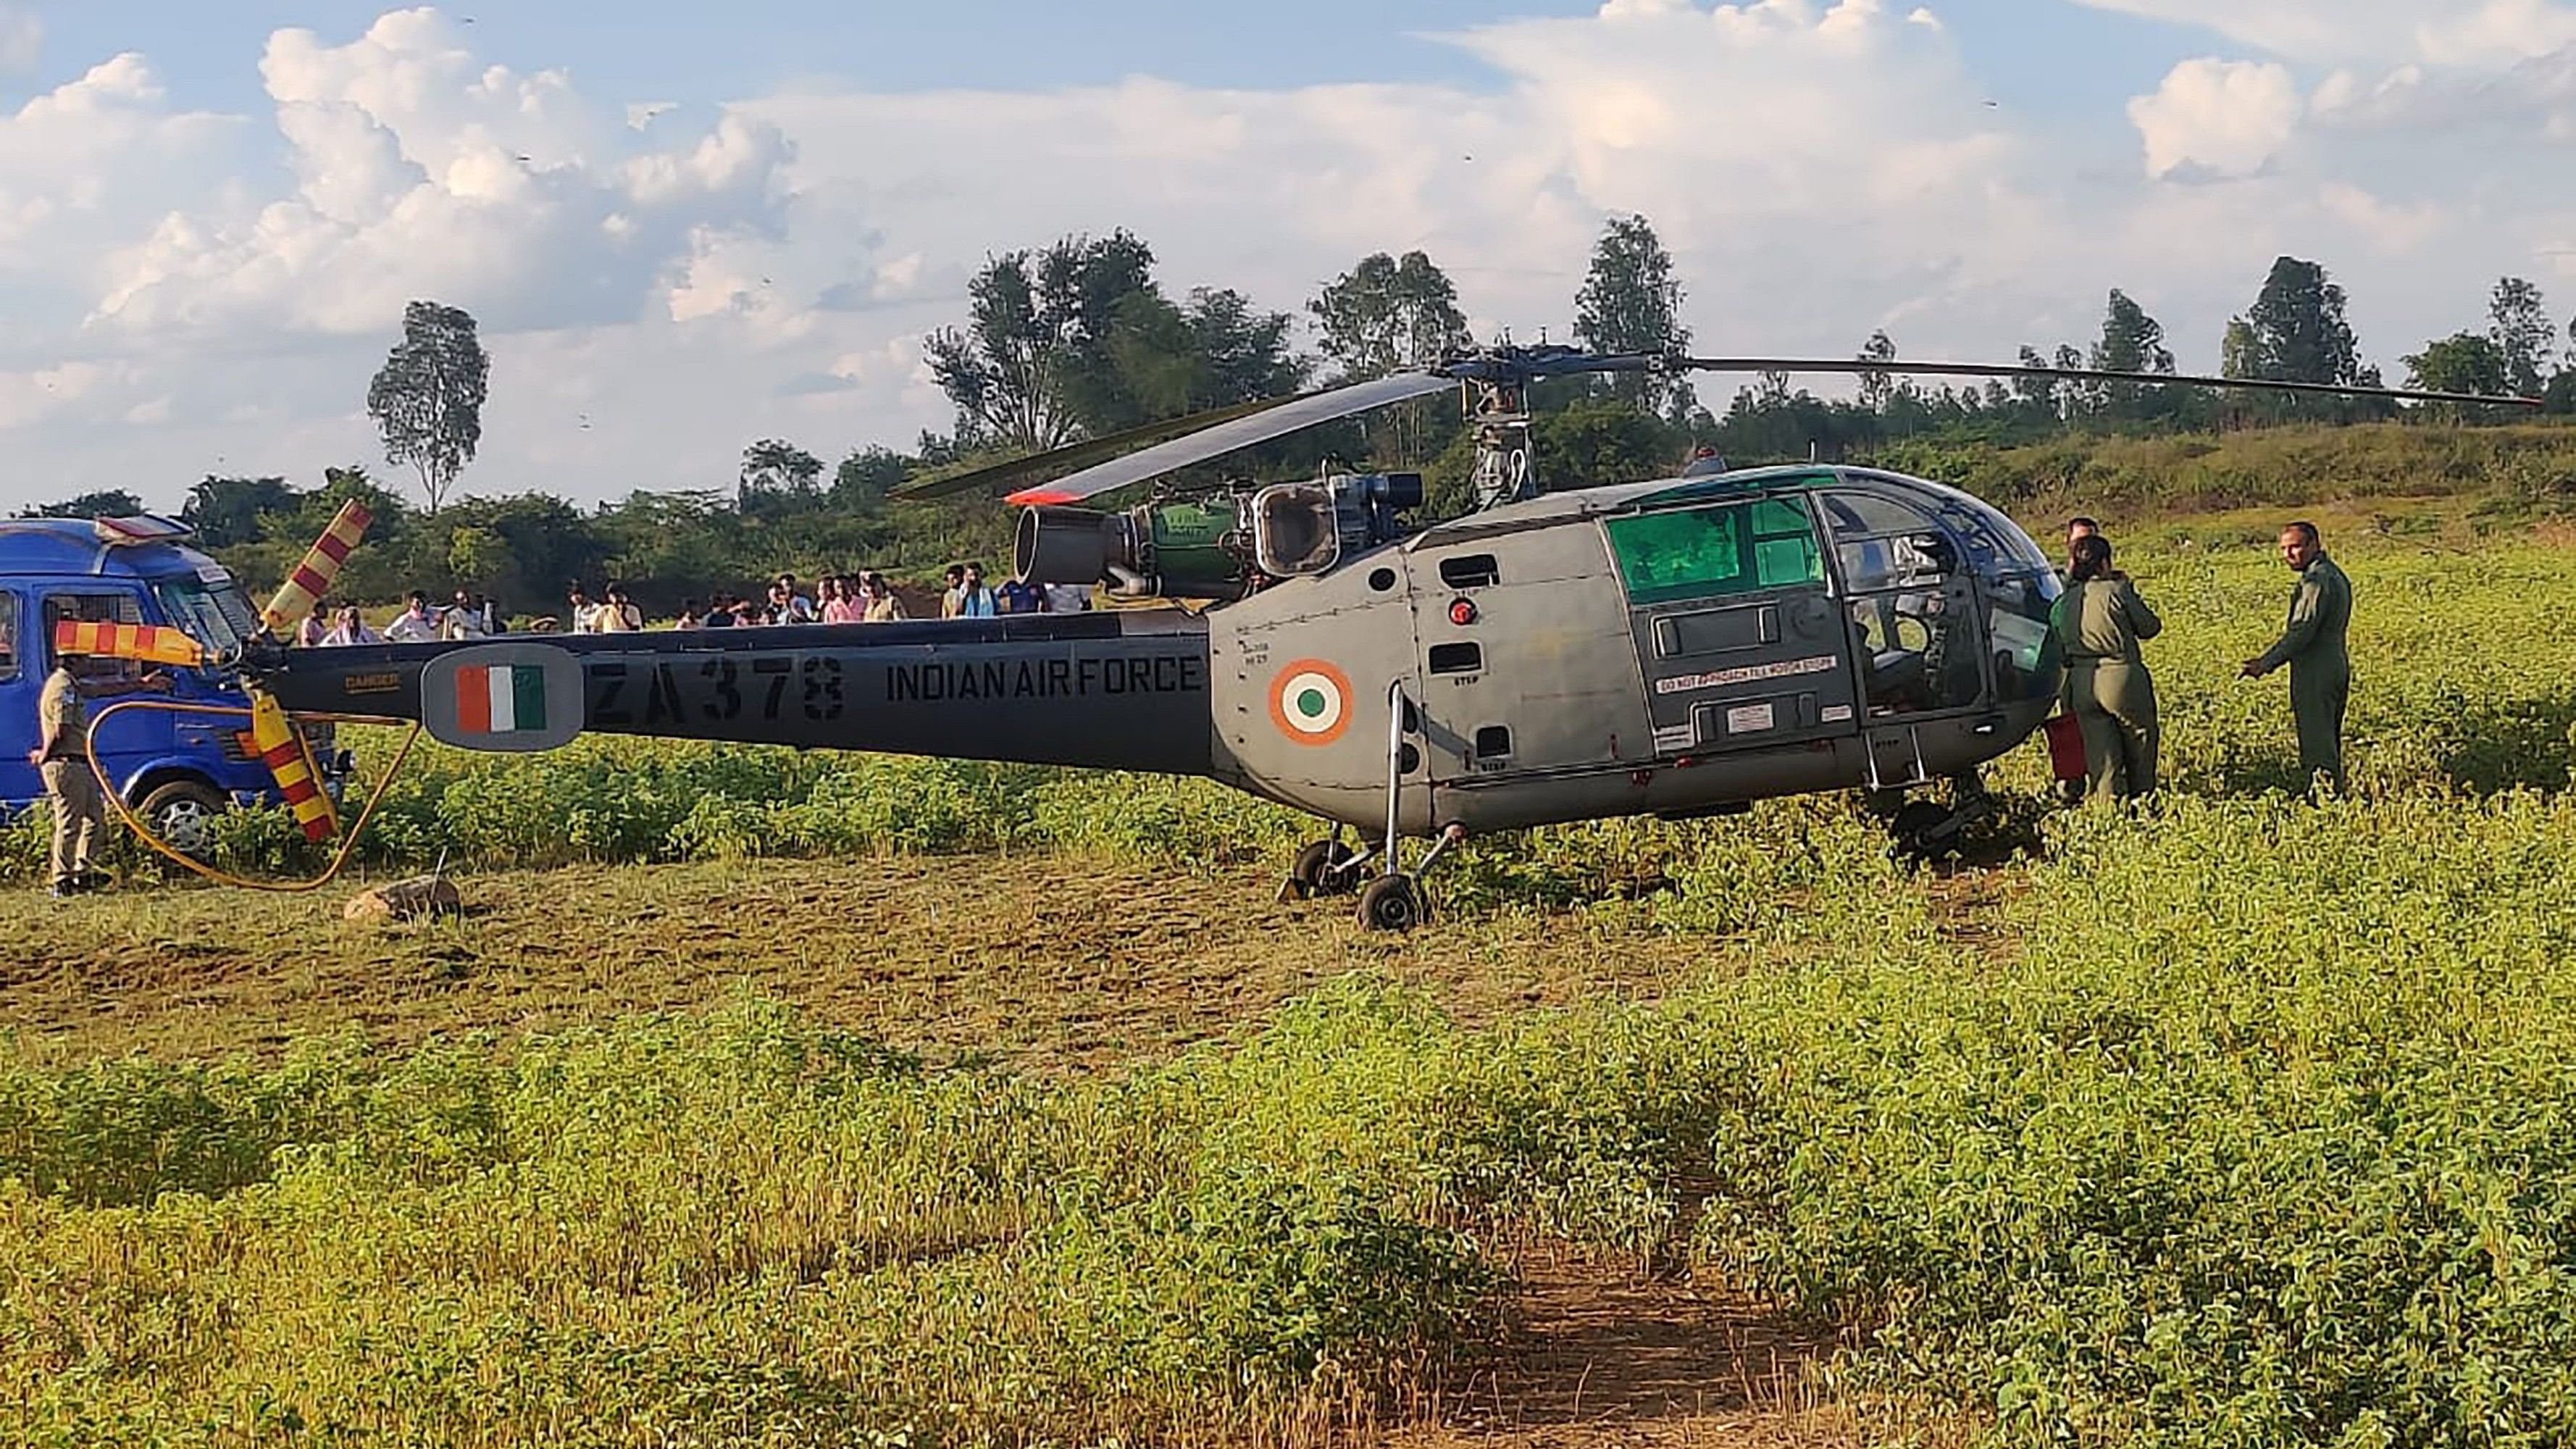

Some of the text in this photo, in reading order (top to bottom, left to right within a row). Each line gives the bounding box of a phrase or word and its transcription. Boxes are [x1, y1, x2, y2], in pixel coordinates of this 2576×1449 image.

[589, 655, 845, 724] ZA378
[887, 655, 1203, 701] INDIAN AIR FORCE
[1661, 680, 1676, 691] DO
[1678, 675, 1695, 688] NOT
